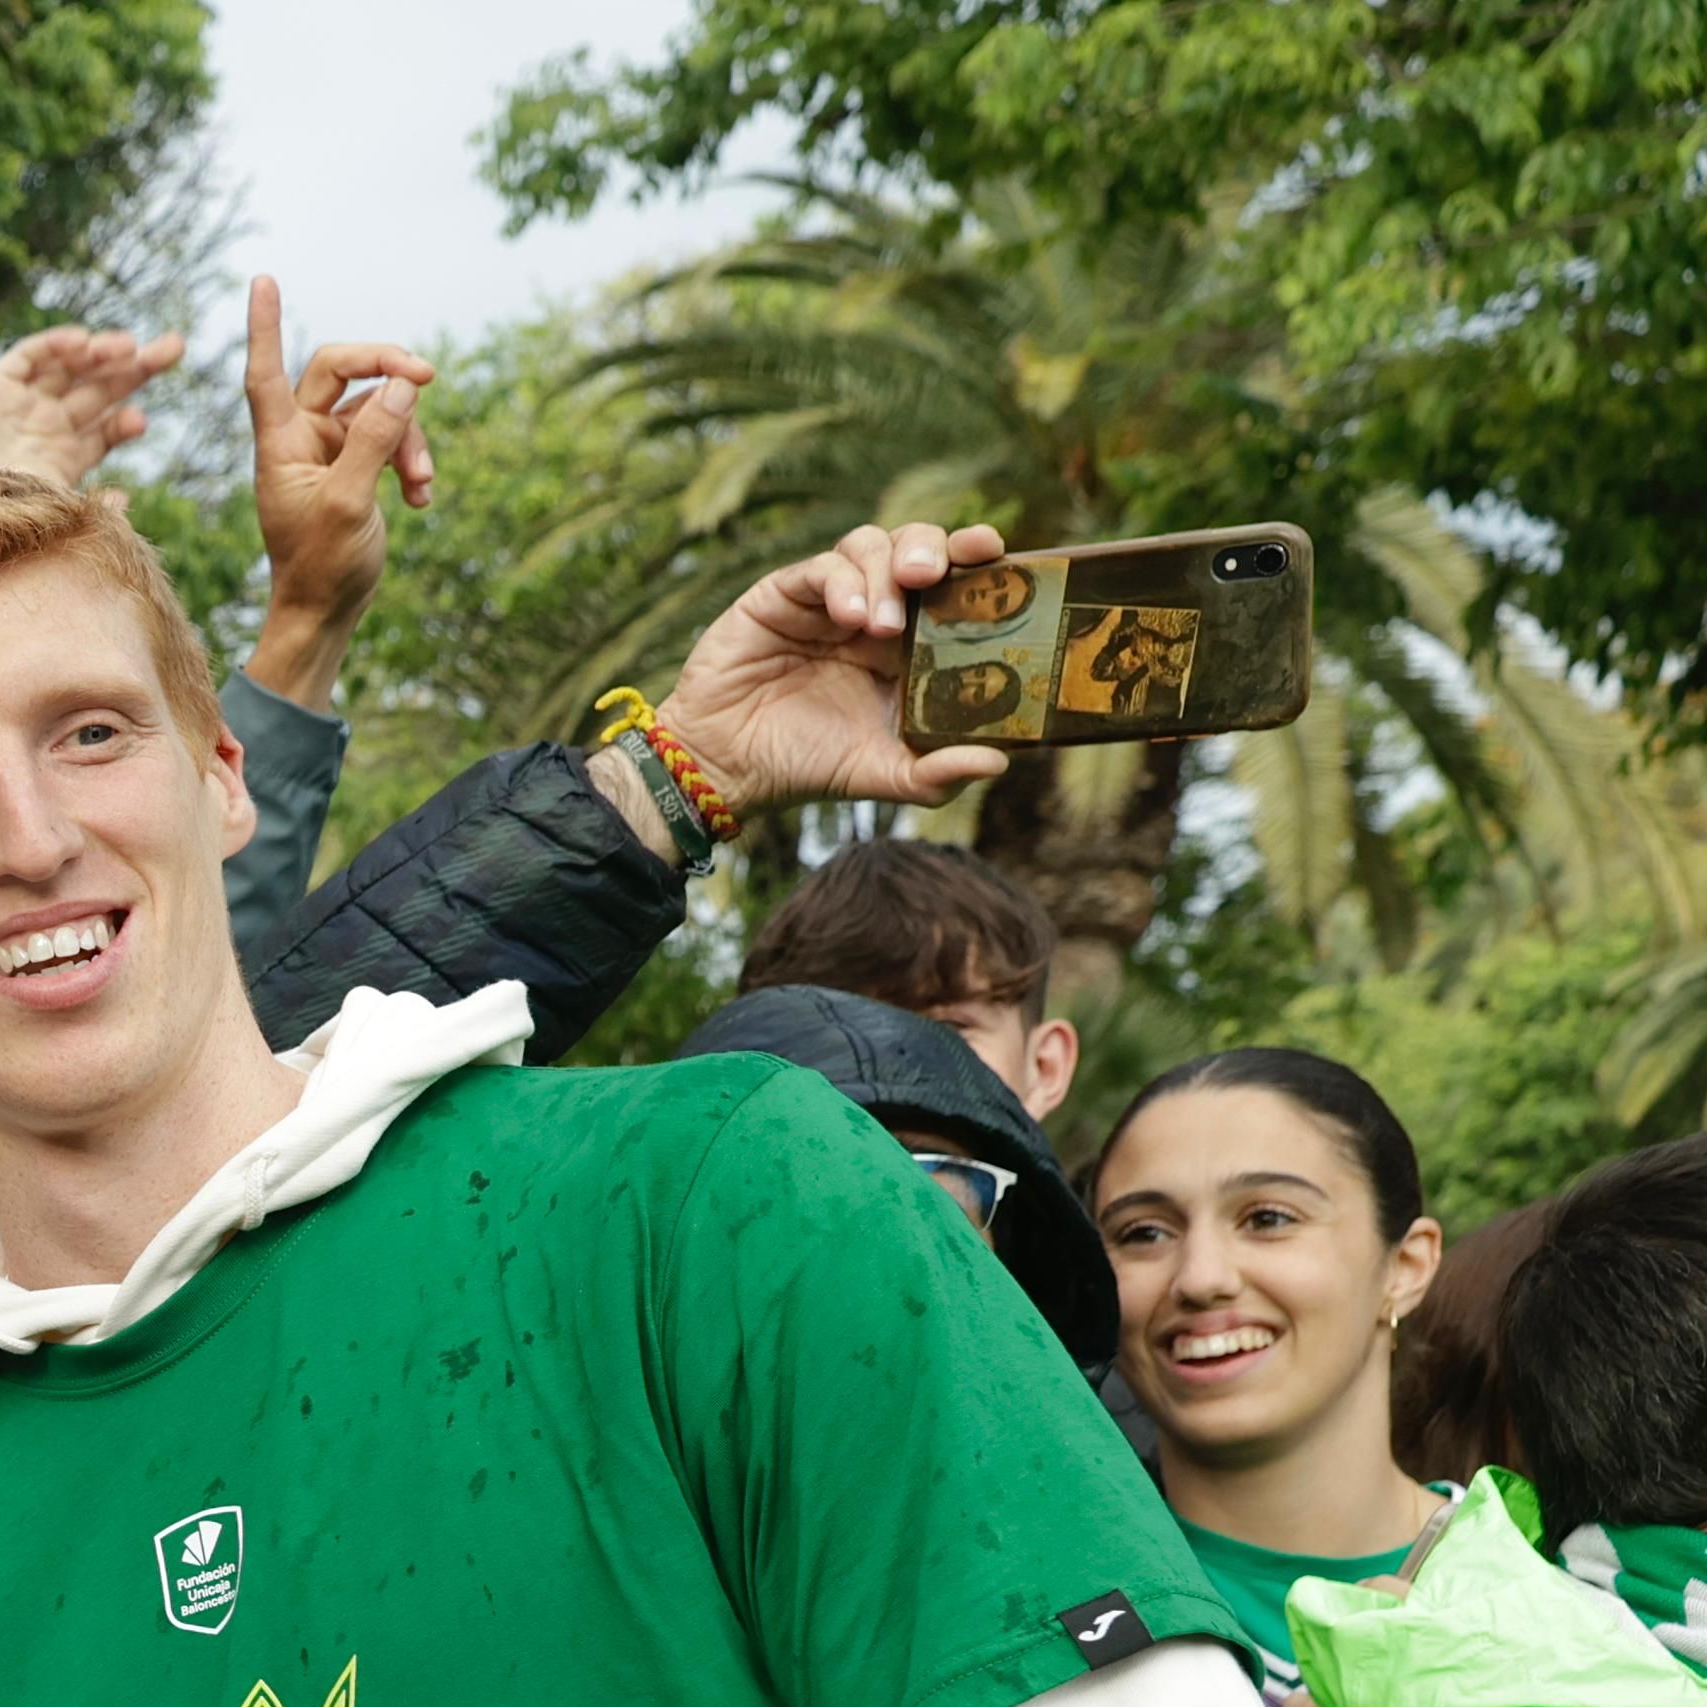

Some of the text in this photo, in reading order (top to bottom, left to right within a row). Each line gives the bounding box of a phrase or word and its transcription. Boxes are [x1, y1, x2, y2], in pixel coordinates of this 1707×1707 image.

[176, 1562, 236, 1591] Fundación
[187, 1579, 232, 1602] Unicaja
[180, 1589, 238, 1617] Baloncesto
